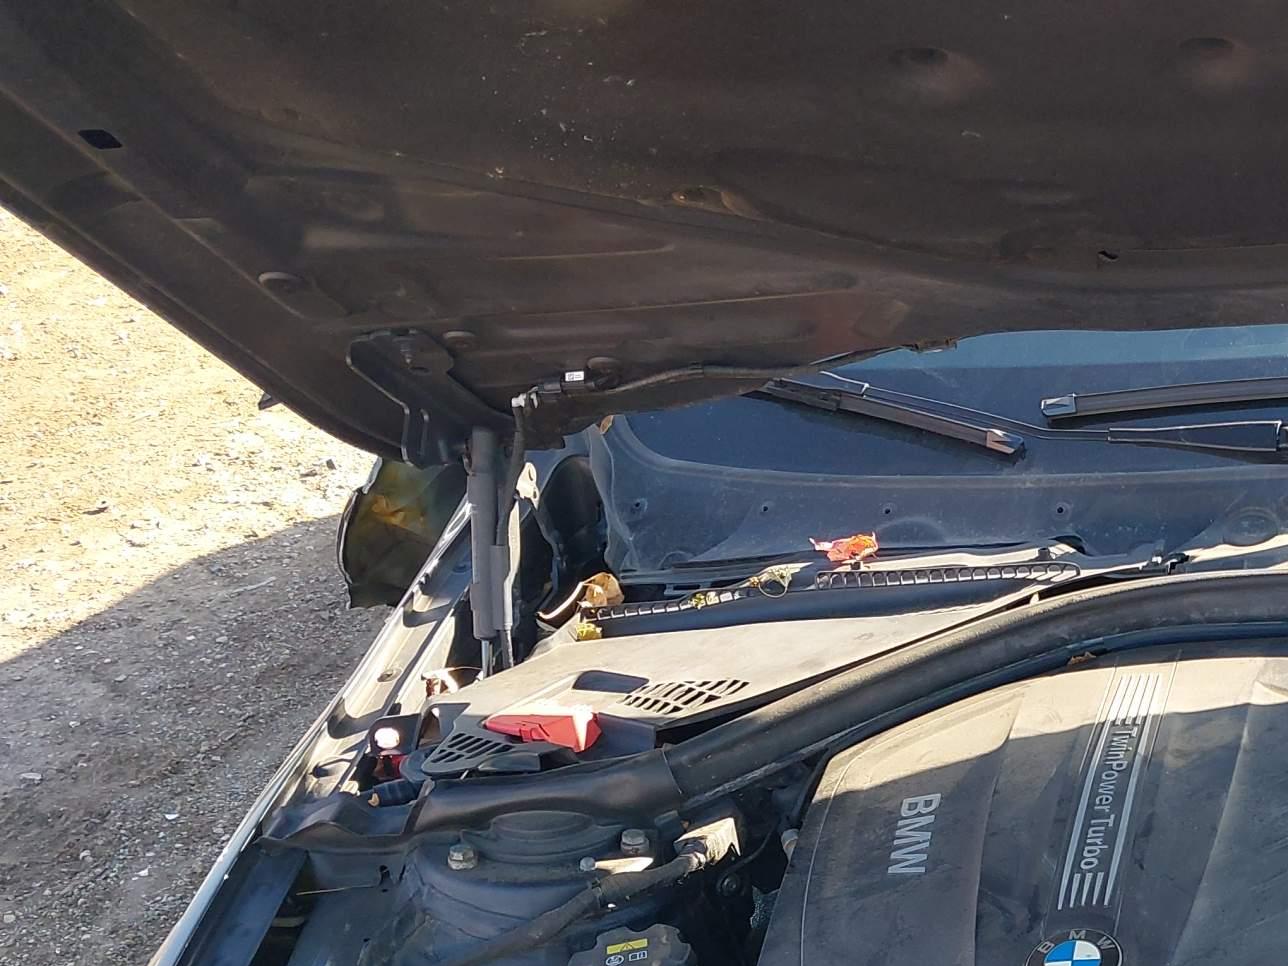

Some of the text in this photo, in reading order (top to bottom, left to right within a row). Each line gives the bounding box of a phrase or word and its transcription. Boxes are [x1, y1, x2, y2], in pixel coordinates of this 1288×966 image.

[887, 793, 942, 874] BMW
[1080, 727, 1137, 870] TwinPower Turbo
[1037, 930, 1115, 954] BMW
